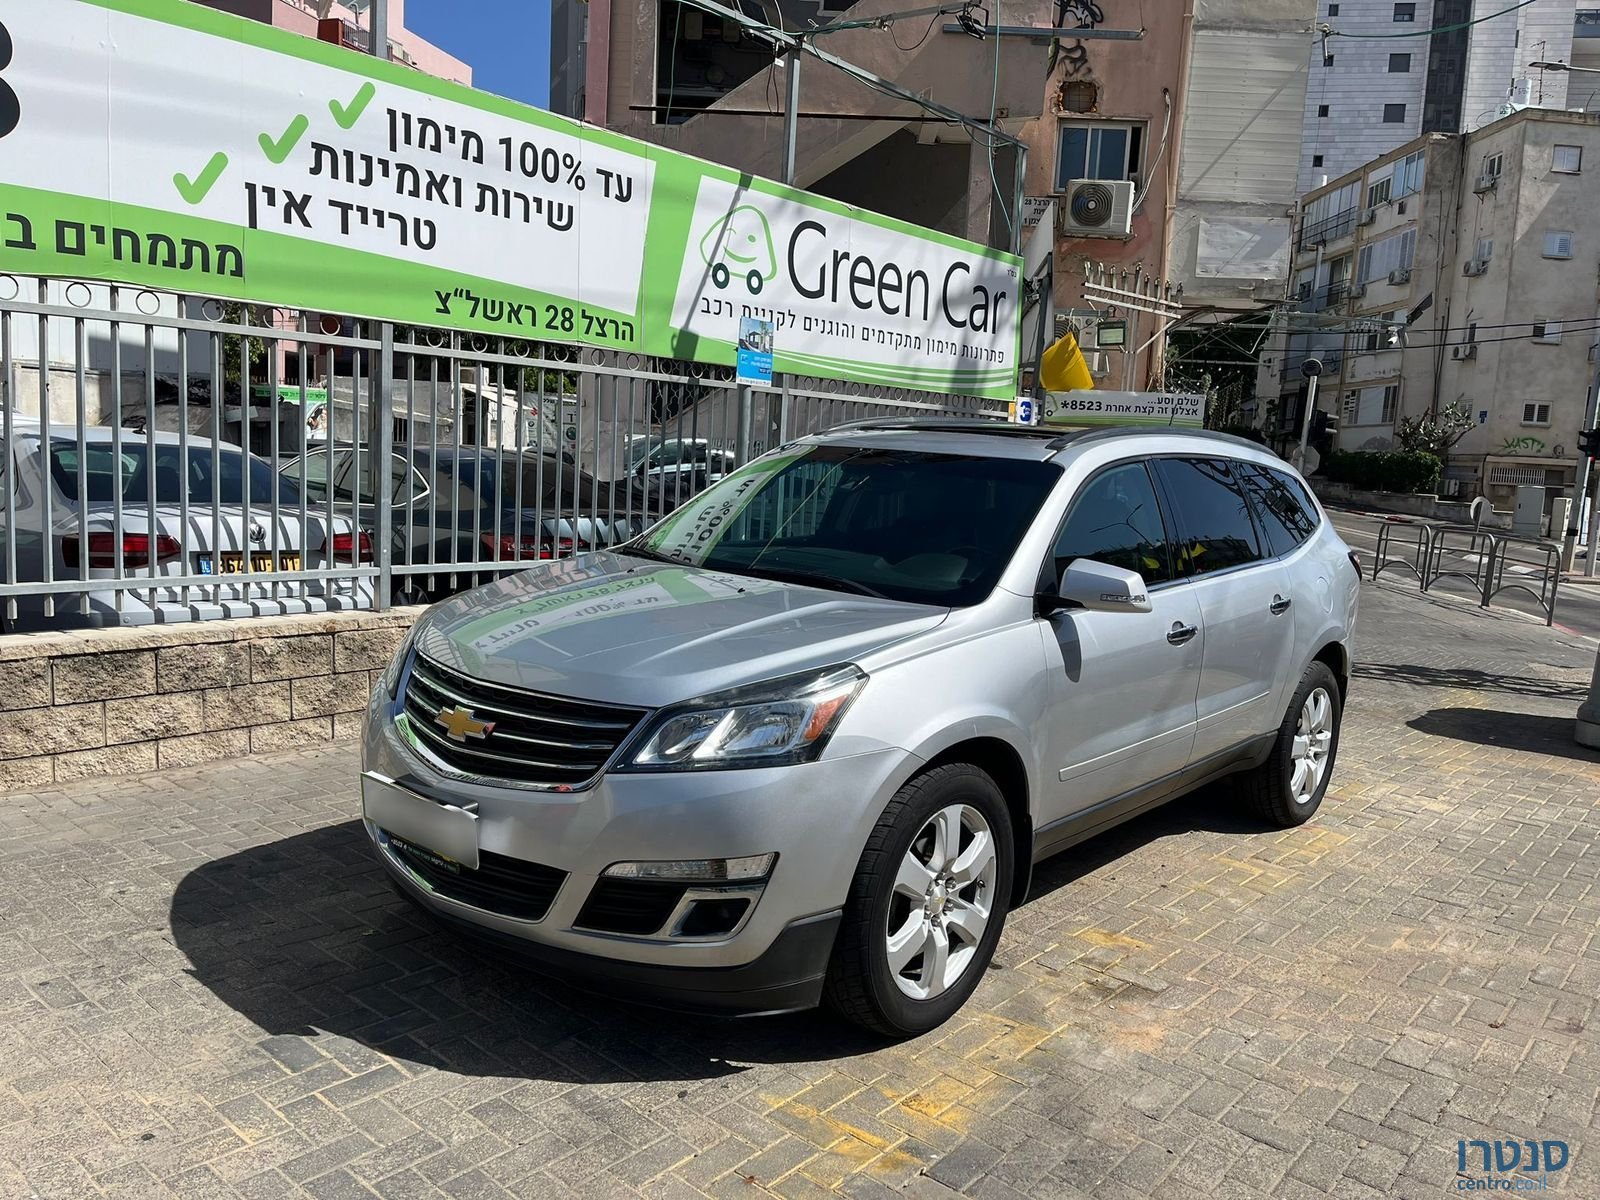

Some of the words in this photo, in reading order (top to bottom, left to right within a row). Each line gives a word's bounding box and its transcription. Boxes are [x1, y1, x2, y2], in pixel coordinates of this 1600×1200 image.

[386, 107, 484, 165] מימון
[309, 141, 462, 208] ואמינות
[499, 137, 586, 191] 100%
[596, 168, 632, 203] עד
[245, 181, 313, 230] אין
[475, 182, 574, 232] שירות
[328, 199, 437, 250] טרייד
[55, 219, 243, 278] מתמחים
[788, 220, 930, 321] Green
[942, 261, 1007, 335] Car
[545, 304, 574, 332] 28
[701, 297, 733, 318] רכב
[581, 309, 634, 342] הרצל
[803, 316, 855, 339] והוגנים
[861, 326, 921, 350] מתקדמים
[926, 338, 958, 356] מימון
[961, 344, 1004, 364] פתרונות
[1105, 404, 1131, 413] אחרת
[1134, 405, 1154, 415] קצת
[1157, 406, 1168, 415] זה
[1177, 397, 1199, 407] שלם
